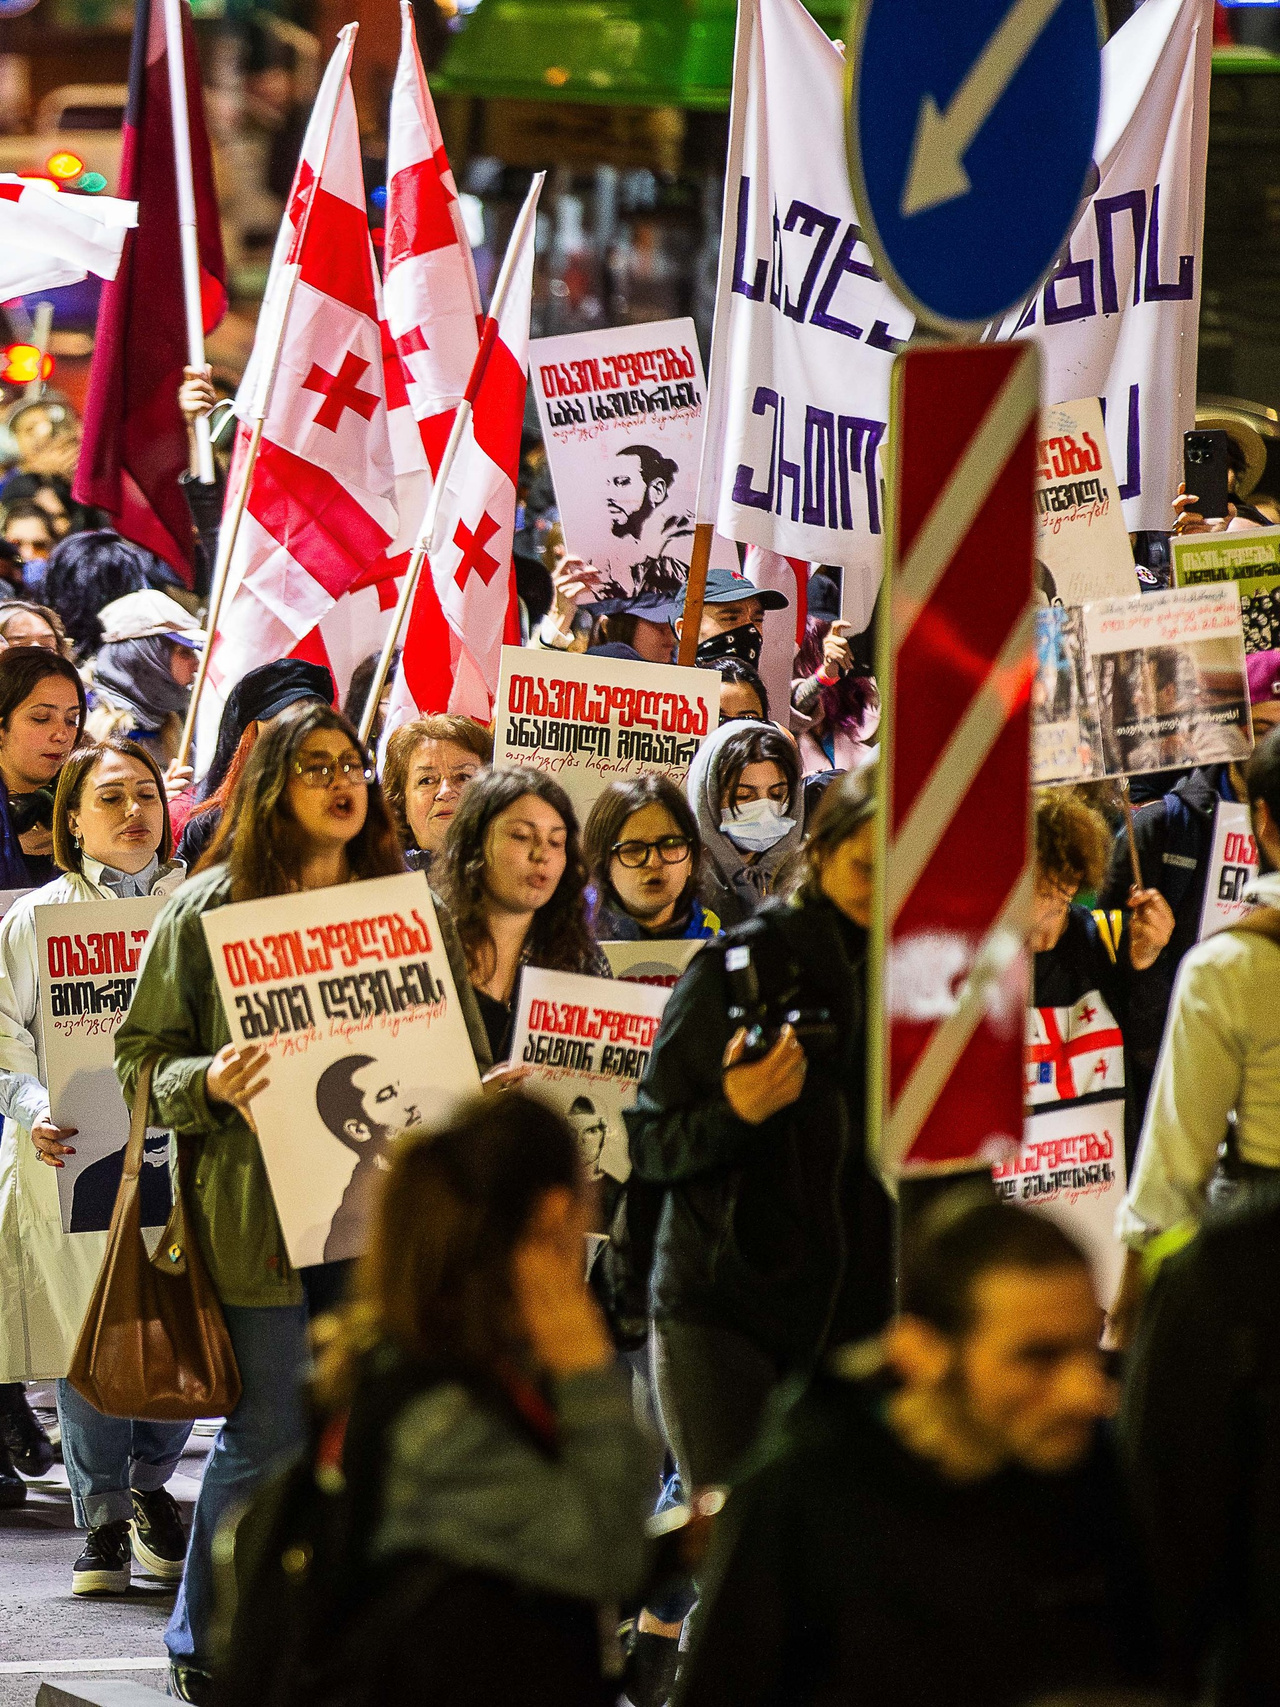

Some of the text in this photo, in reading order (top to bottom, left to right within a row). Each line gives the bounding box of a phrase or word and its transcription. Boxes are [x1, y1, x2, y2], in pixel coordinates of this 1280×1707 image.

[539, 345, 696, 398] თავისუფლება
[545, 396, 586, 427] საბა
[508, 674, 709, 736] თავისუფლება
[505, 747, 580, 773] თავისუფლება
[506, 716, 611, 757] ანატოლი
[47, 929, 150, 978] თავისუ
[222, 909, 432, 988] თავისუფლება
[54, 1008, 123, 1036] თავისუფლებ
[234, 961, 447, 1039] მათე დევიძეს
[528, 999, 662, 1047] თავისუფლე
